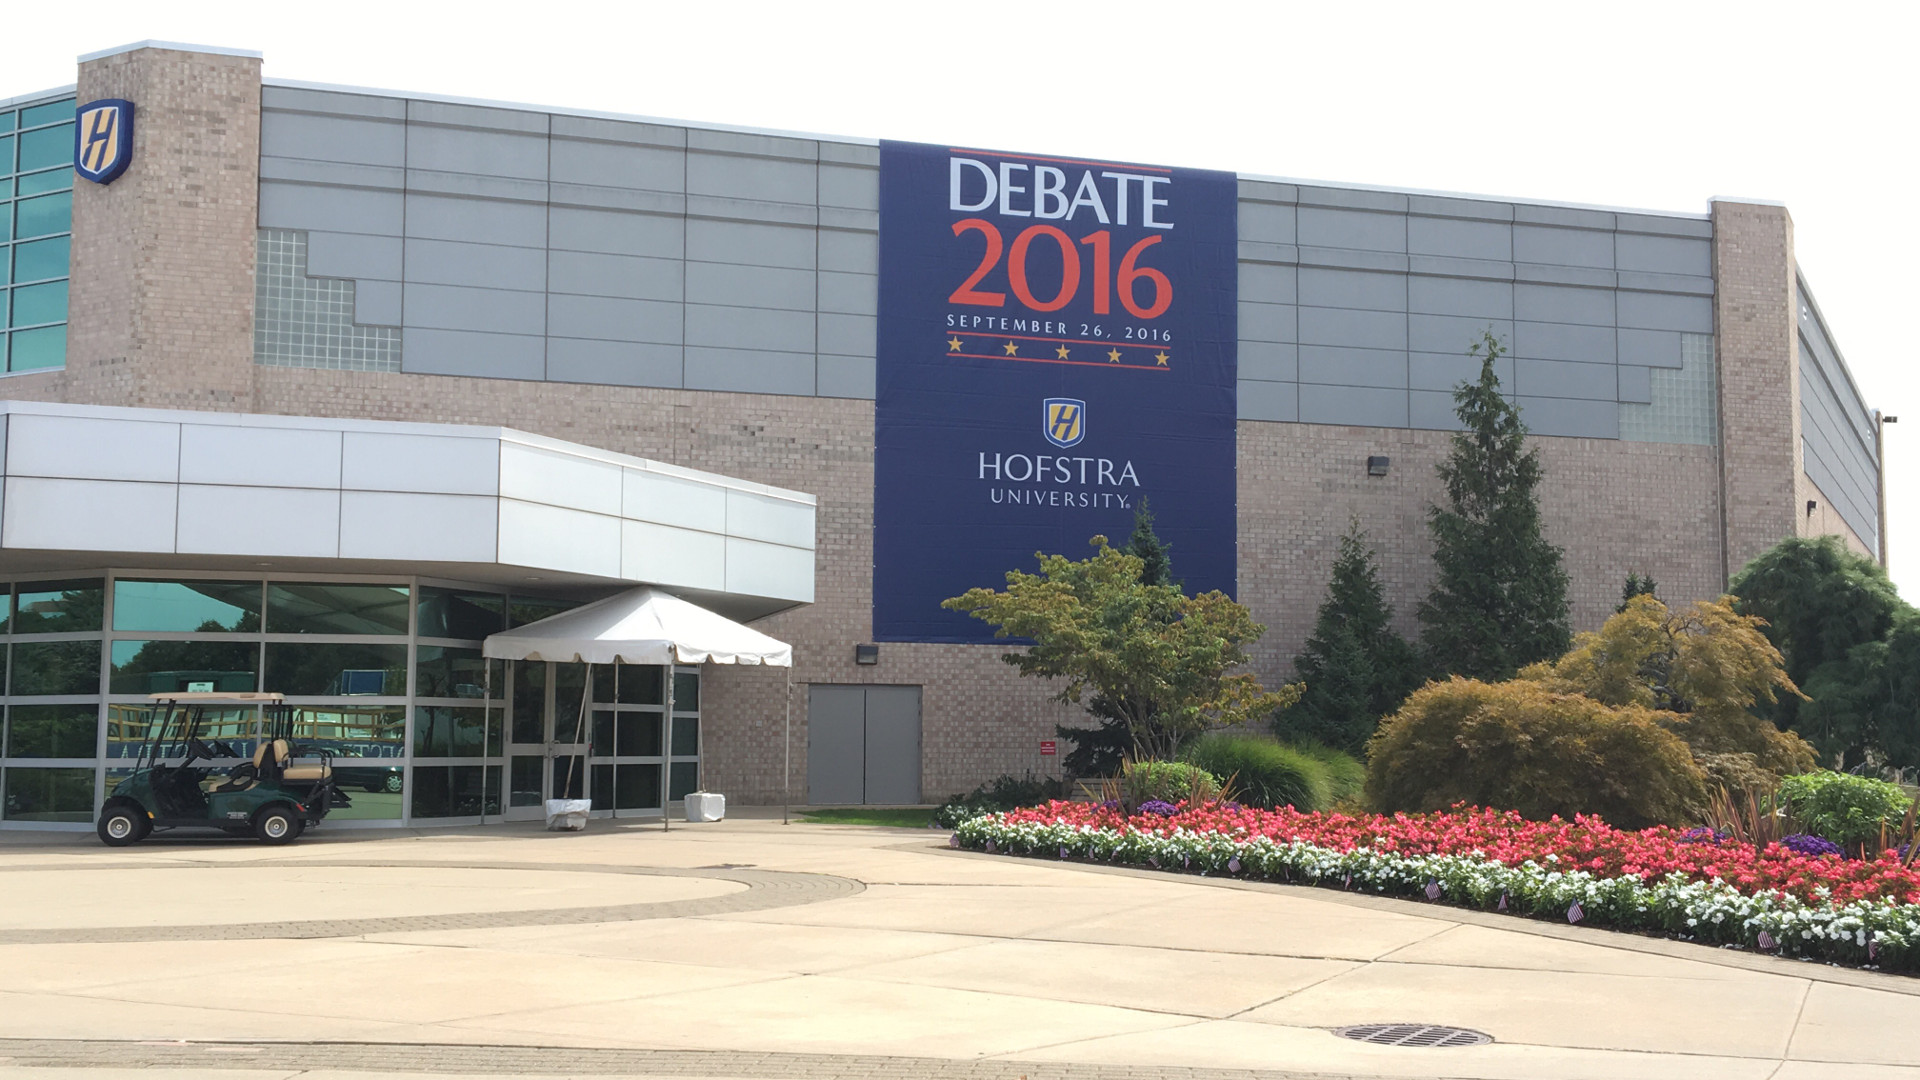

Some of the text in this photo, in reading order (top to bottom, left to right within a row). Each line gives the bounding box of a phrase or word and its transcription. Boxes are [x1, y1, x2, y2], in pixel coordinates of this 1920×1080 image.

[949, 156, 1174, 230] DEBATE
[948, 218, 1173, 320] 2016
[947, 313, 1171, 342] SEPTEMBER 26, 2016
[979, 452, 1141, 487] HOFSTRA
